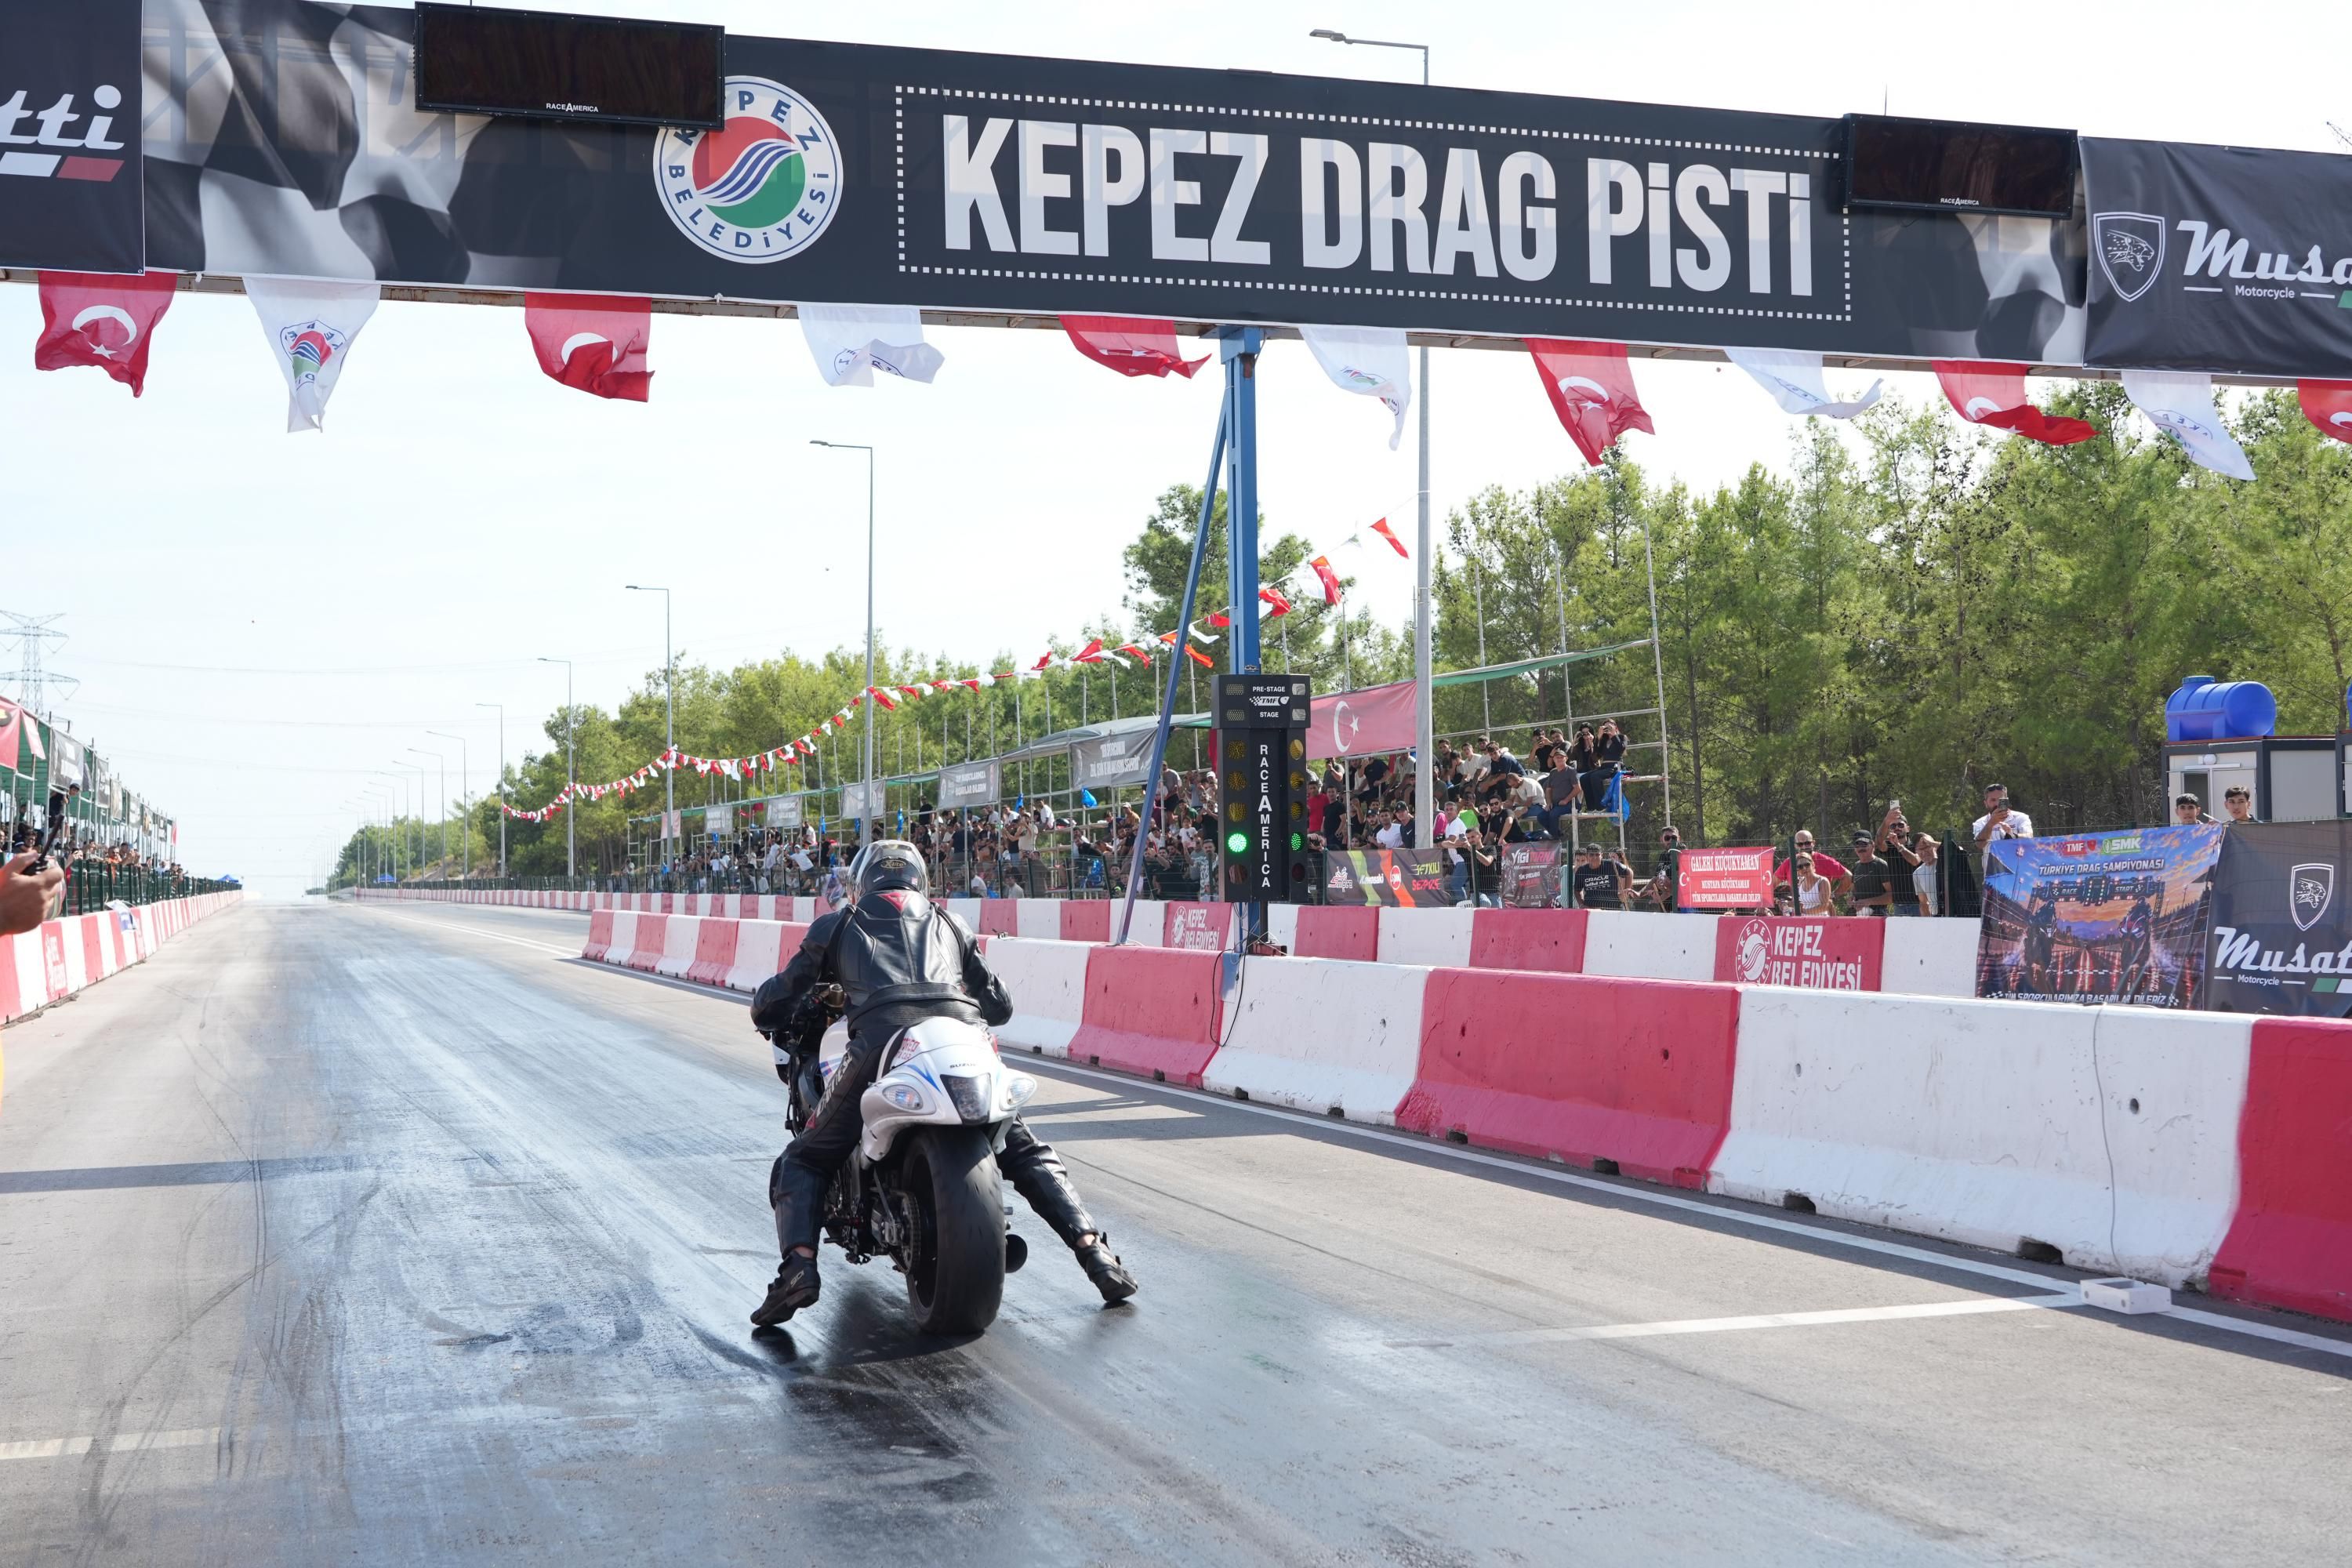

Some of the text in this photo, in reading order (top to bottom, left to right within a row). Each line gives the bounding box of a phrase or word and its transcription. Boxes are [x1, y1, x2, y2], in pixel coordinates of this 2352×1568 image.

[546, 103, 599, 112] RACEAMERICA
[943, 114, 1270, 265] KEPEZ
[1301, 137, 1557, 281] DRAG
[2234, 285, 2295, 299] Motorcycle
[1258, 744, 1272, 887] RACEAMERICA
[2066, 843, 2085, 852] TMF
[2111, 837, 2142, 851] SMK
[1691, 851, 1714, 872] GALERİ
[2039, 858, 2165, 876] TÜRKİYE DRAG ŞAMPİYONASI
[1187, 909, 1207, 928] KEPEZ
[1774, 925, 1824, 956] KEPEZ
[2238, 974, 2280, 986] Motorcycle
[2133, 993, 2166, 1005] DİLERİZ
